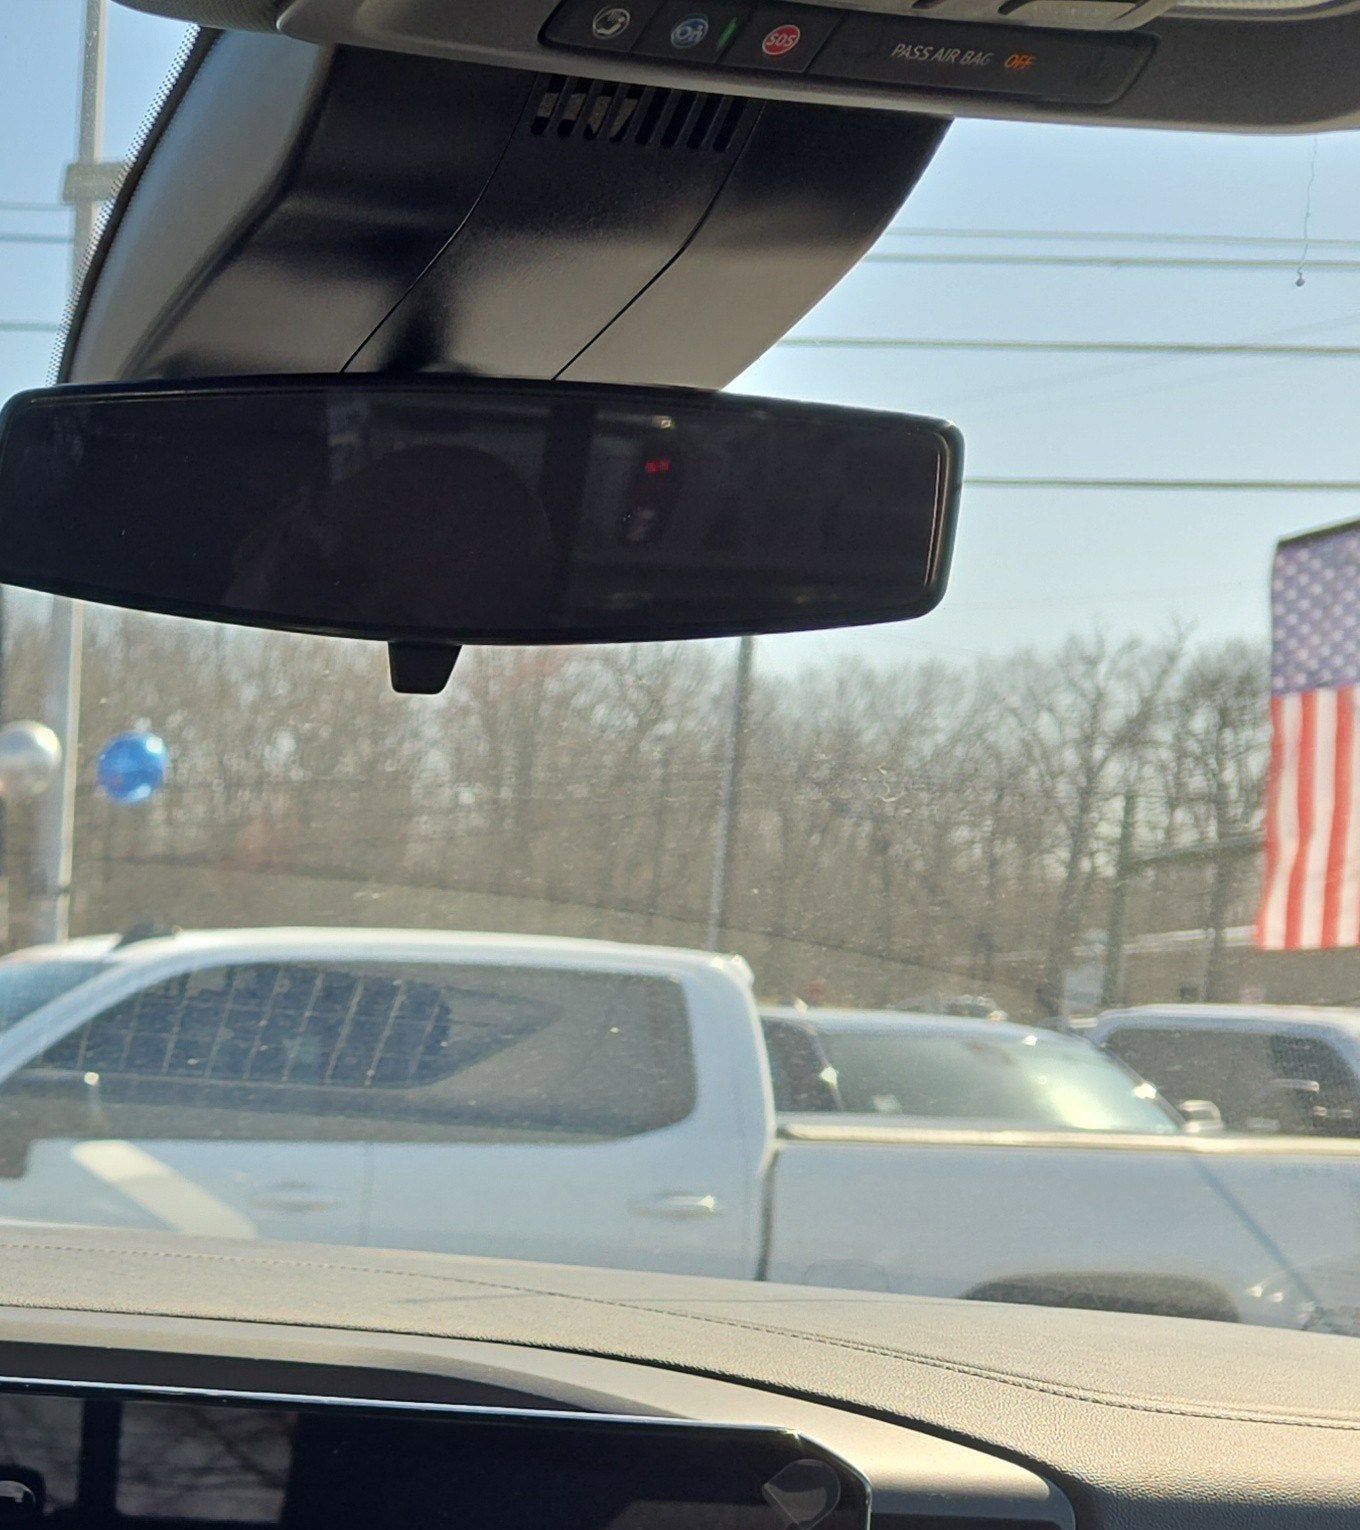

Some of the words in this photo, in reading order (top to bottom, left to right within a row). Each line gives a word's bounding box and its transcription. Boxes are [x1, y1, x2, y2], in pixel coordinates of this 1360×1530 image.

[766, 32, 797, 47] SOS
[891, 43, 934, 61] PASS
[931, 47, 961, 64] AIR
[959, 51, 995, 66] BAG
[1003, 52, 1037, 69] OFF
